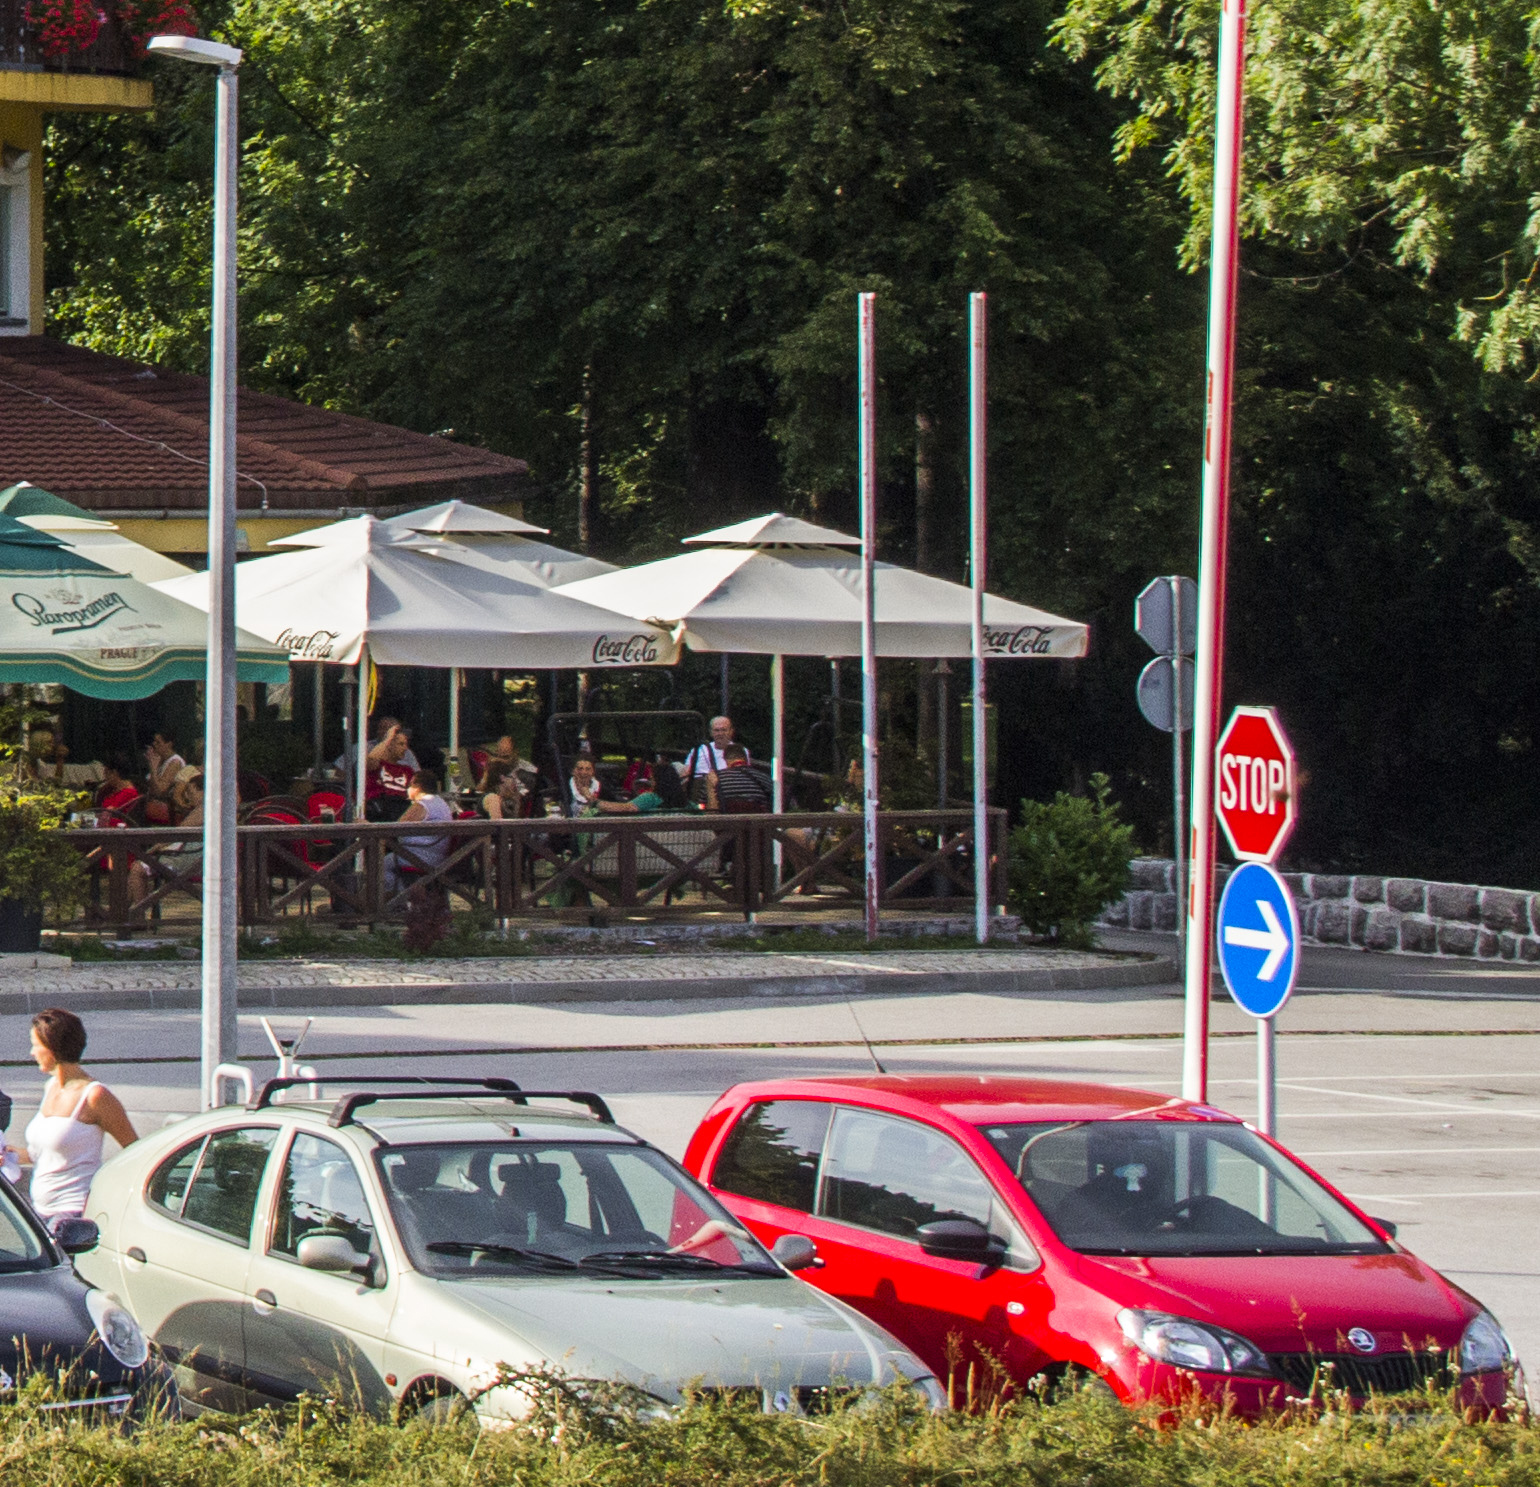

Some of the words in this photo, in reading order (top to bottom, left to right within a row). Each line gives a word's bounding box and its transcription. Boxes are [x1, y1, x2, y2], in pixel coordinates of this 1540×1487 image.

[12, 592, 138, 634] Staropramen
[592, 634, 658, 663] Coca-Cola
[1222, 753, 1284, 815] STOP
